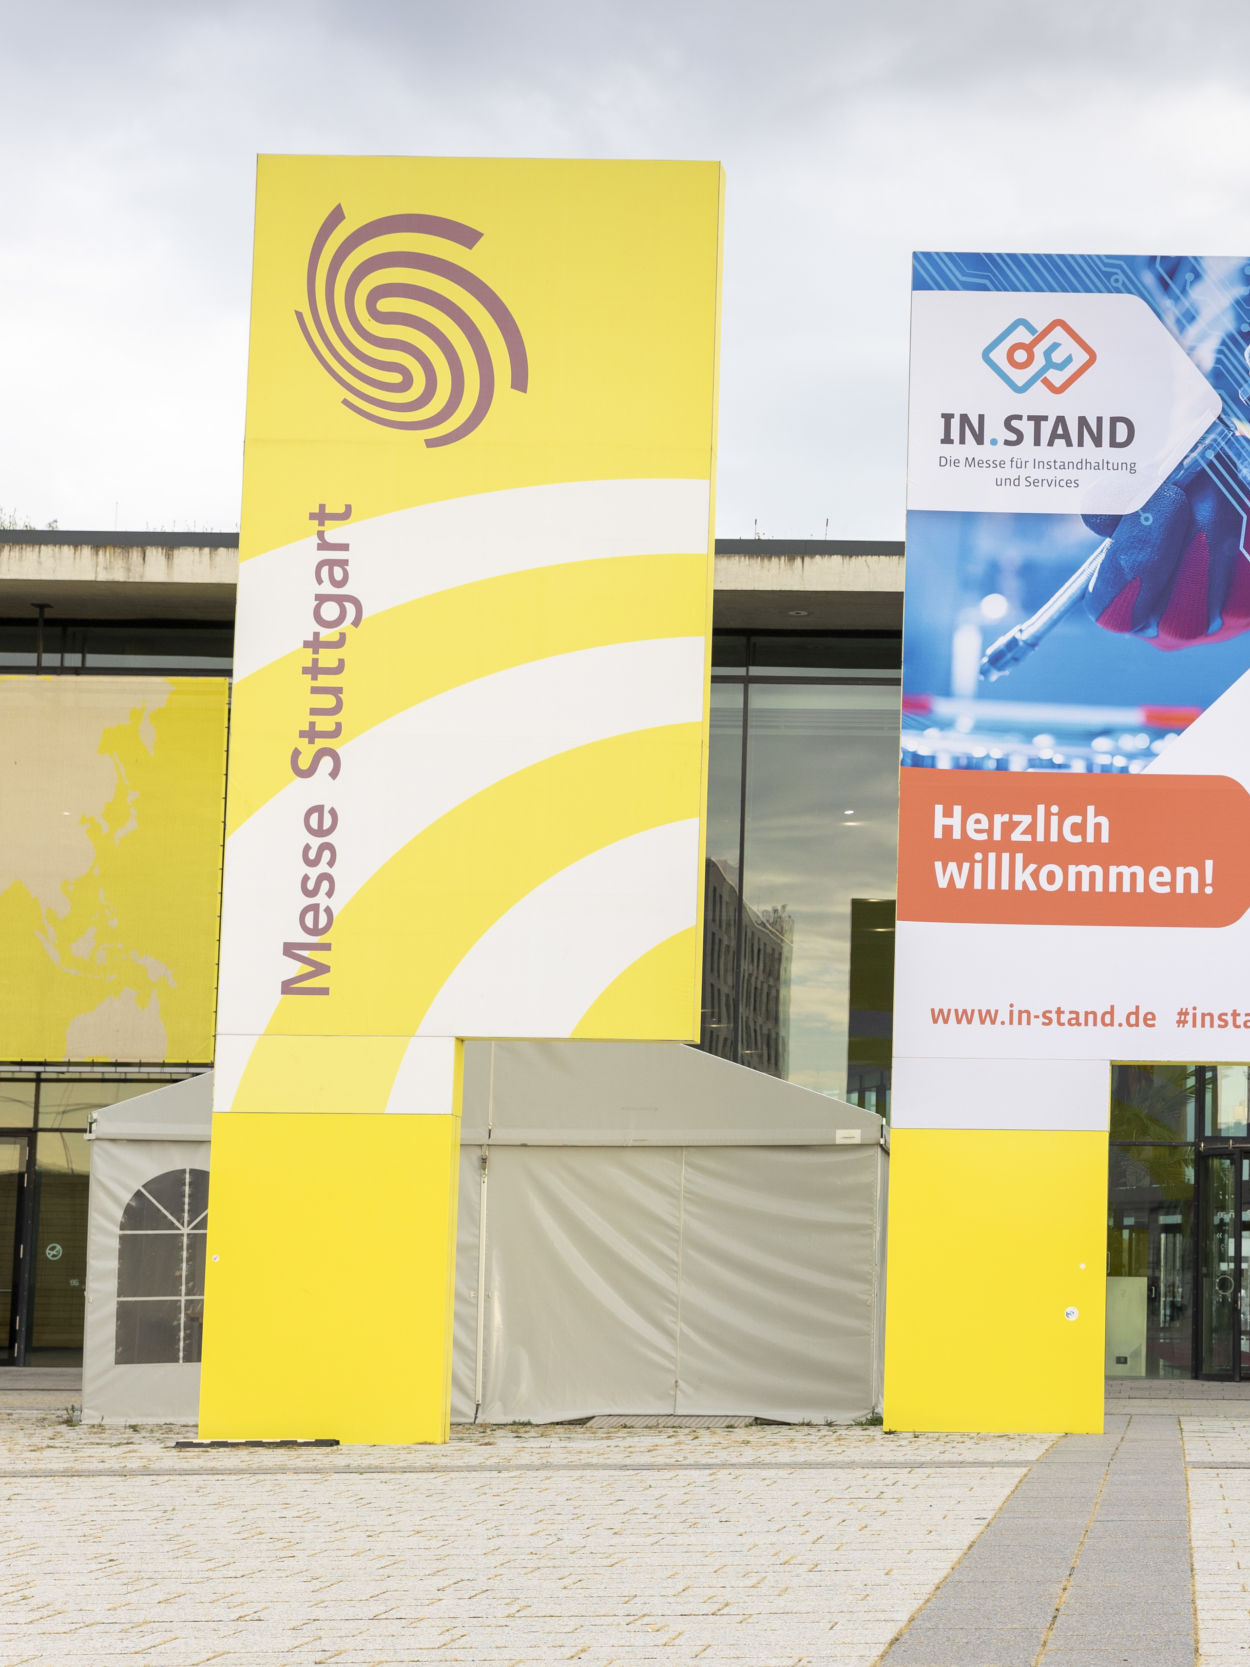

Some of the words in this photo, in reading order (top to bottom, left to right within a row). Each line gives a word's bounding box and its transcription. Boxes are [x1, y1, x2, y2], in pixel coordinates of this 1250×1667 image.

[940, 412, 1136, 449] IN.STAND
[938, 455, 961, 468] Die
[964, 456, 1006, 469] Messe
[1009, 456, 1030, 469] für
[1033, 458, 1137, 475] Instandhaltung
[995, 475, 1021, 487] und
[1024, 475, 1080, 489] Services
[290, 502, 364, 781] Stuttgart
[933, 803, 1110, 844] Herzlich
[934, 851, 1215, 895] willkommen!
[280, 803, 340, 997] Messe
[930, 1002, 1157, 1029] www.in-stand.de
